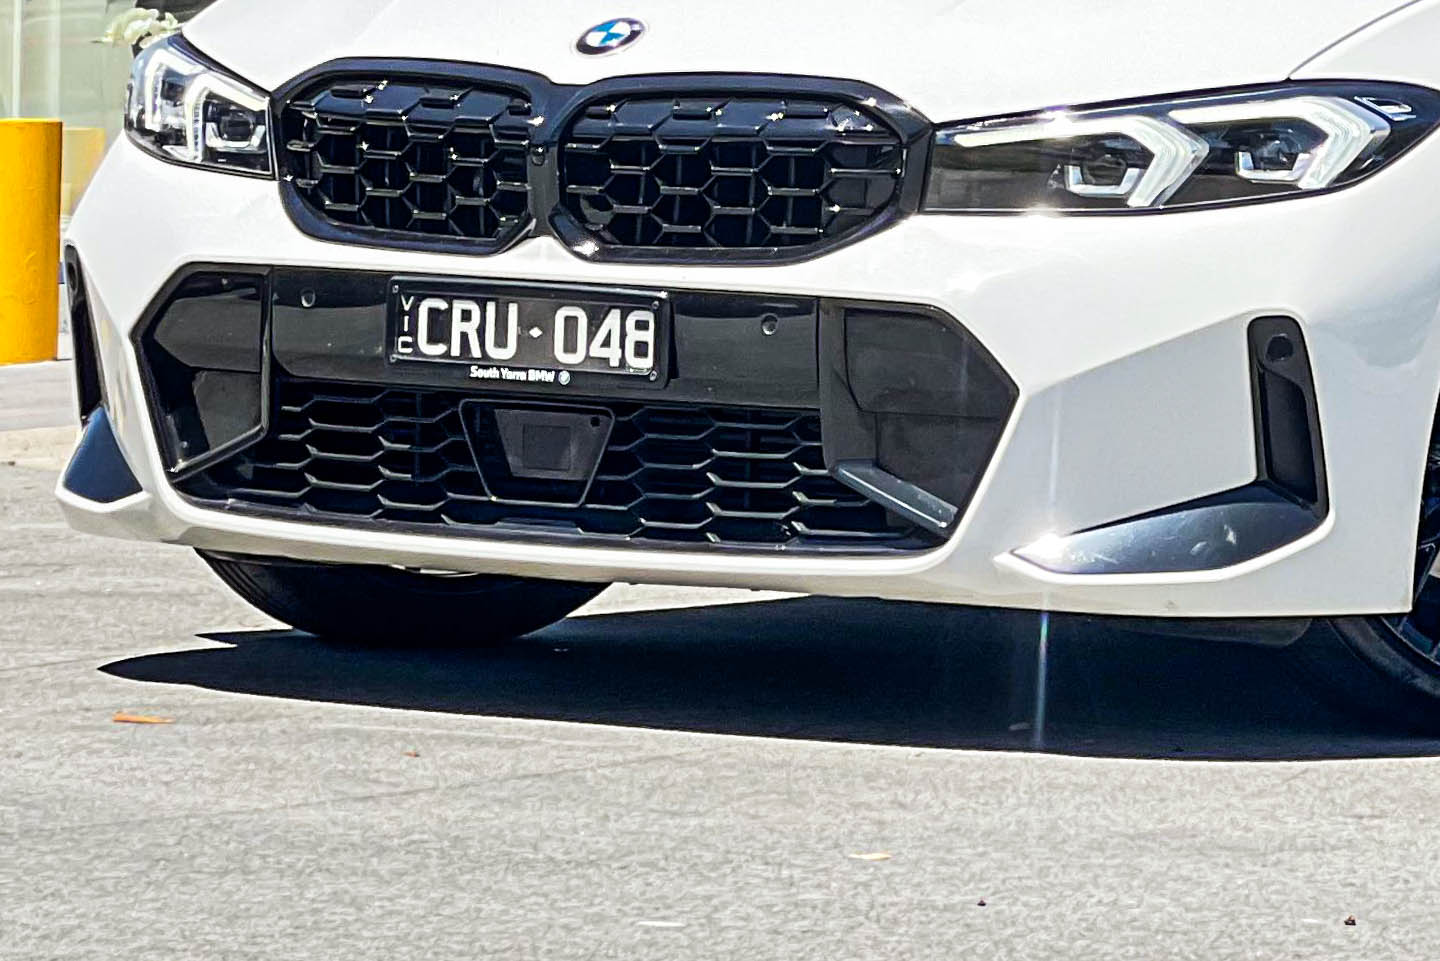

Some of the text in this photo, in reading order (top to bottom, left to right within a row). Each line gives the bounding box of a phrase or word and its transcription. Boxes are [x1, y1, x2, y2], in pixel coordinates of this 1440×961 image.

[398, 295, 415, 354] VIC
[416, 297, 655, 368] CRU 048
[469, 365, 556, 382] South Yarra BMW
